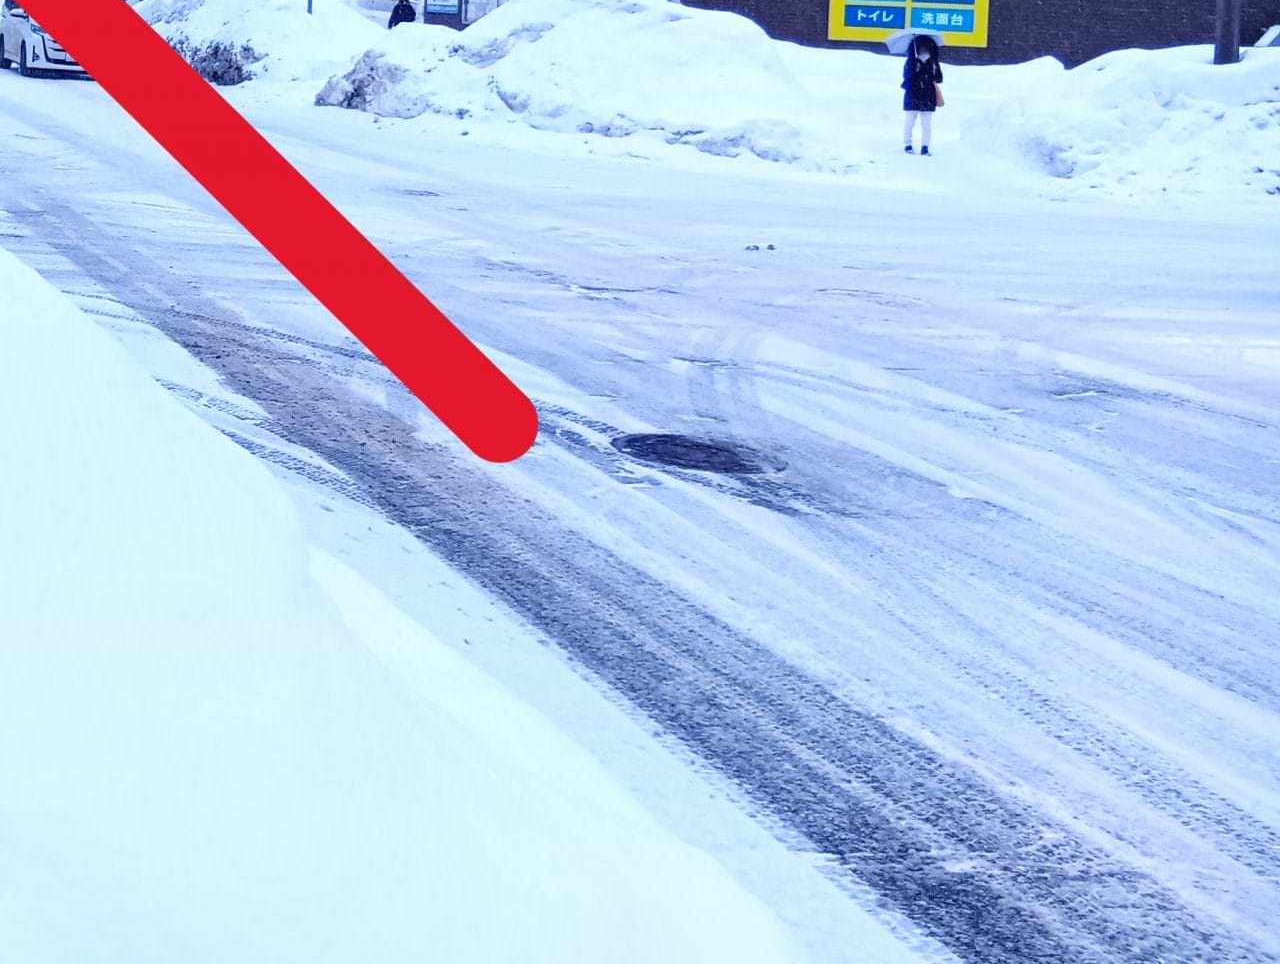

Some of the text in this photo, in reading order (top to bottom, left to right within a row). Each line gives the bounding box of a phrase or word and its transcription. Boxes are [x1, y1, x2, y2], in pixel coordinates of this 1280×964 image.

[857, 10, 894, 22] トイレ
[921, 12, 963, 26] 洗面台
